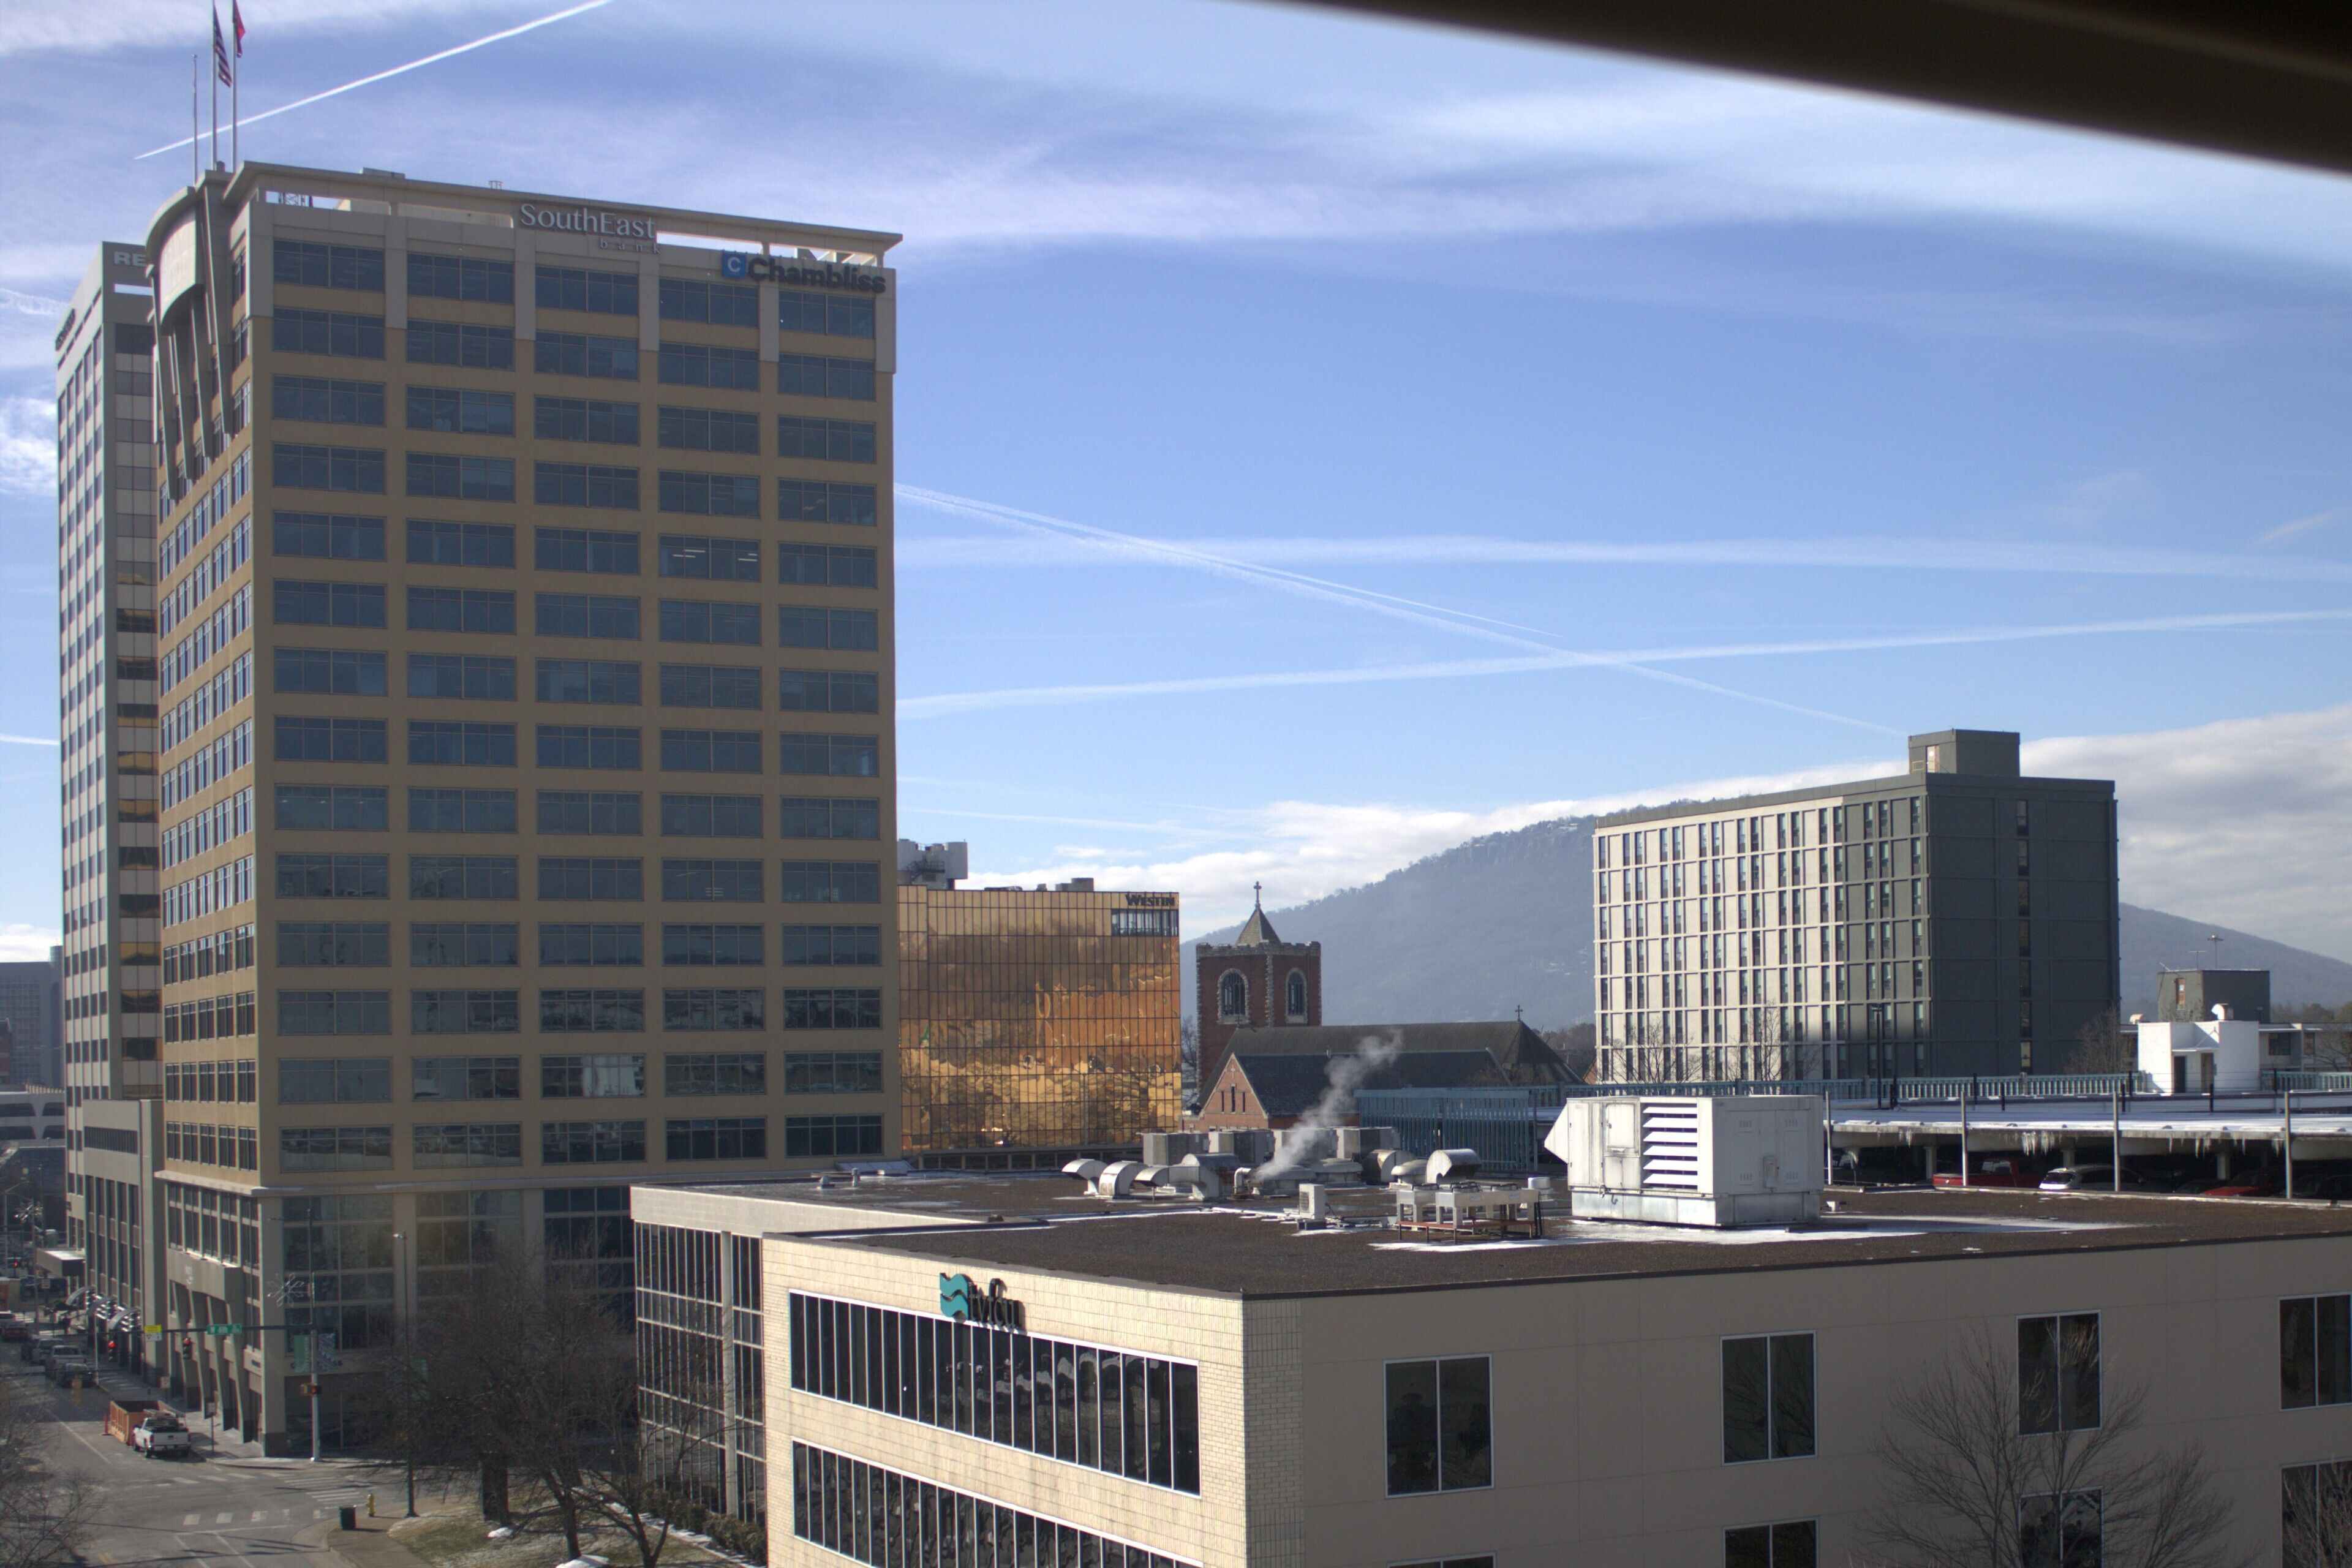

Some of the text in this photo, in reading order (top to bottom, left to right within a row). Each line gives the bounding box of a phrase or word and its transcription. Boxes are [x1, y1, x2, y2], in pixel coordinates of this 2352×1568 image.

[521, 203, 655, 238] SouthEast
[600, 237, 660, 255] bank
[728, 257, 886, 294] C Chambliss
